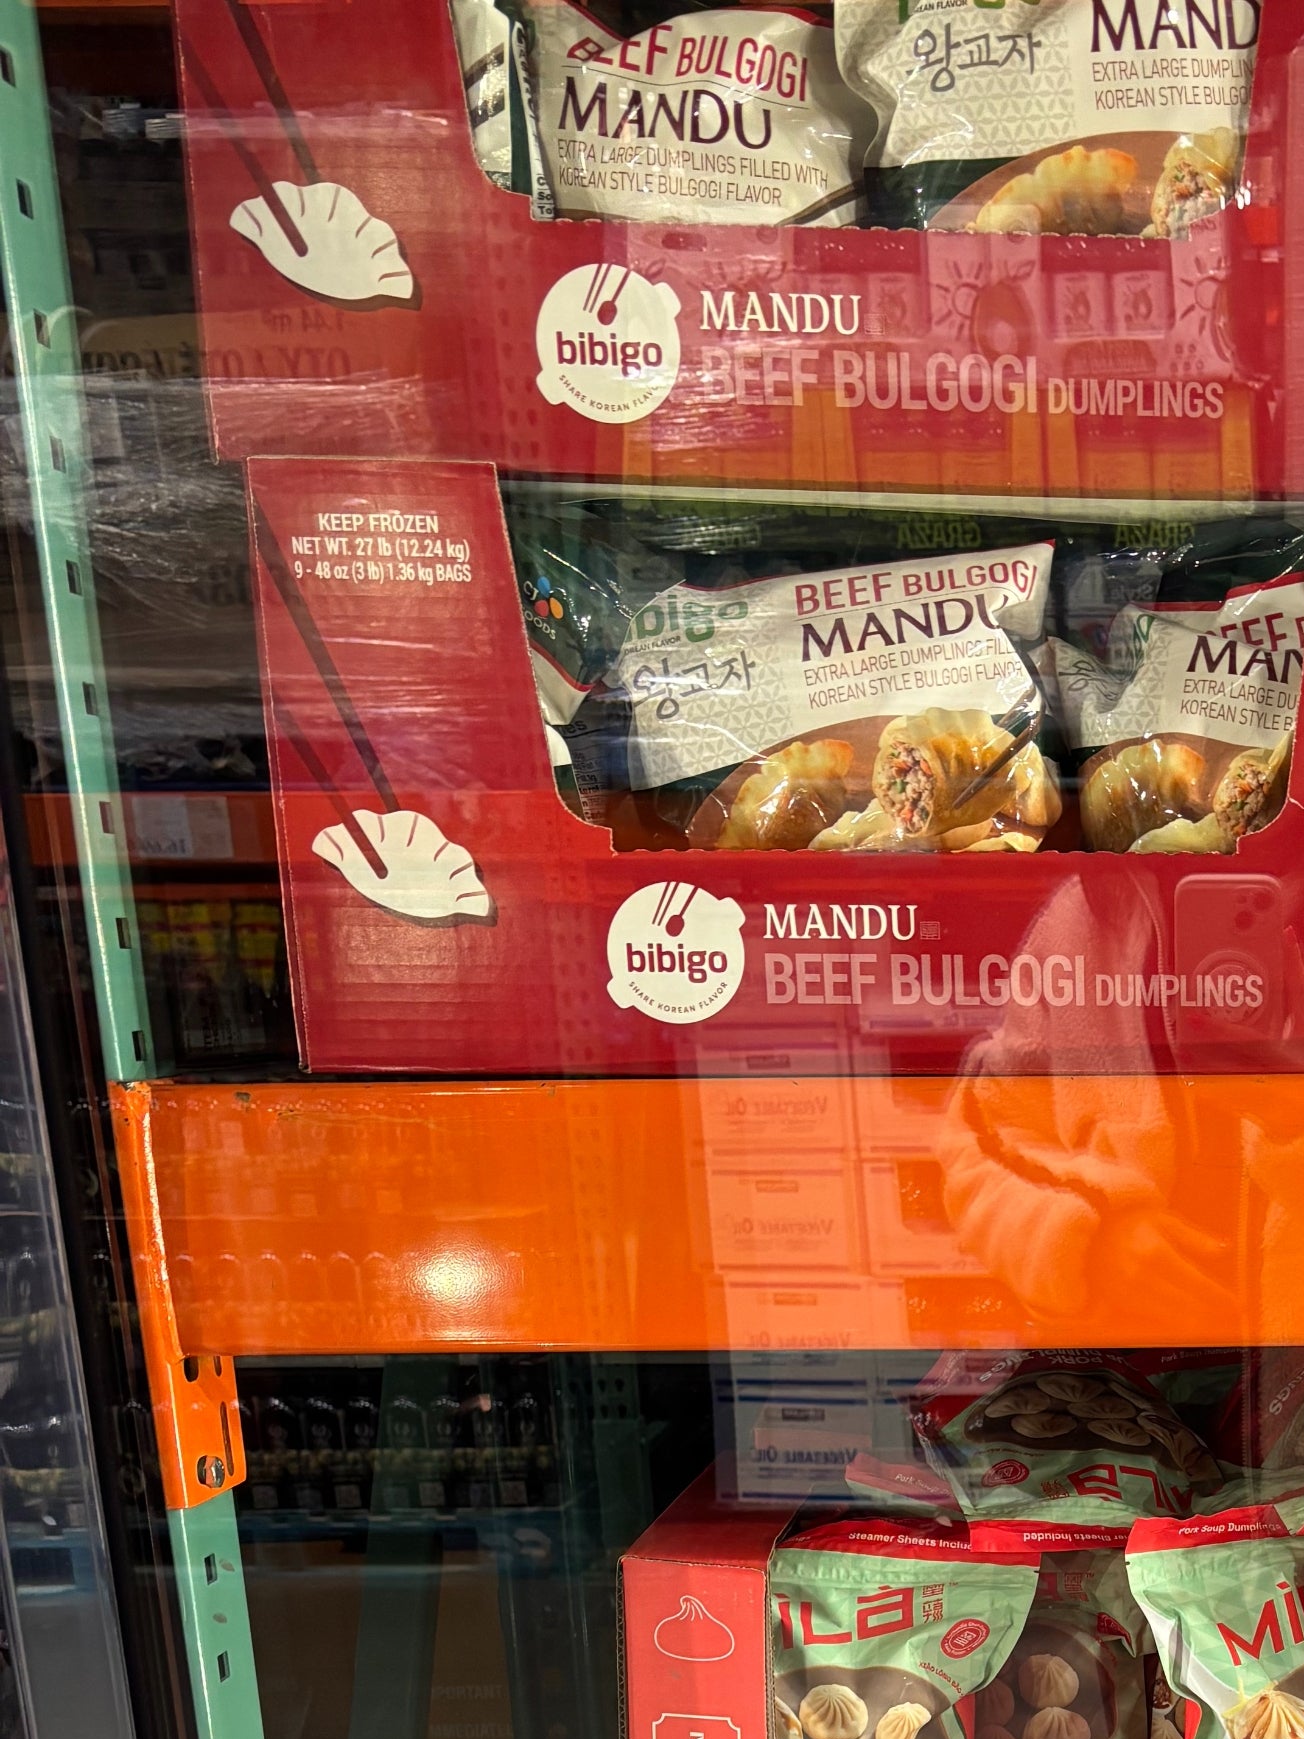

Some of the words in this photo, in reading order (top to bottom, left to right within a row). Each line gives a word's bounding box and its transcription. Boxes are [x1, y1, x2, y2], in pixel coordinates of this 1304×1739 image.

[567, 25, 671, 75] BEEF
[675, 36, 807, 102] BULGOGI
[906, 22, 1041, 93] 왕교자
[1092, 59, 1135, 83] EXTRA
[1140, 57, 1189, 80] LARGE
[558, 75, 772, 149] MANDU
[1094, 86, 1156, 110] KOREAN
[1160, 85, 1199, 107] STYLE
[557, 138, 597, 163] EXTRA
[600, 142, 643, 166] LARGE
[646, 146, 735, 173] DUMPLINGS
[739, 155, 791, 180] FILLED
[795, 163, 829, 190] WITH
[558, 166, 605, 191] KOREAN
[608, 171, 655, 194] STYLE
[658, 175, 723, 200] BULGOGI
[726, 182, 783, 206] FLAVOR
[700, 290, 861, 335] MANDU
[556, 331, 663, 377] bibigo
[702, 348, 819, 406] BEEF
[833, 350, 1038, 413] BULGOGI
[1047, 377, 1224, 419] DUMPLINGS
[318, 513, 364, 532] KEEP
[368, 513, 440, 533] FROZEN
[292, 538, 321, 555] NET
[324, 538, 353, 556] WT.
[356, 538, 375, 556] 27
[378, 538, 392, 556] lb
[395, 538, 443, 561] (12.24
[445, 538, 471, 562] kg)
[294, 562, 303, 579] 9
[315, 563, 332, 580] 48
[335, 566, 348, 580] oz
[351, 562, 366, 583] (3
[368, 563, 384, 584] lb)
[387, 563, 413, 583] 1.36
[417, 564, 433, 584] kg
[436, 564, 473, 583] BAGS
[794, 571, 892, 616] BEEF
[903, 560, 1038, 601] BULGOGI
[800, 593, 1008, 662] MANDU
[631, 650, 756, 720] 왕교자
[803, 659, 847, 686] EXTRA
[850, 652, 898, 679] LARGE
[902, 642, 983, 672] DUMPLINGS
[809, 681, 867, 709] KOREAN
[870, 672, 913, 697] STYLE
[915, 666, 973, 689] BULGOGI
[762, 904, 918, 941] MANDU
[626, 943, 728, 983] bibigo
[764, 953, 877, 1005] BEEF
[891, 954, 1084, 1008] BULGOGI
[1096, 974, 1263, 1009] DUMPLINGS
[629, 982, 655, 1006] SHARE
[657, 1003, 696, 1014] KOREAN
[699, 982, 728, 1009] FLAVOR
[849, 1532, 894, 1542] Steamer
[898, 1535, 936, 1547] Sheets
